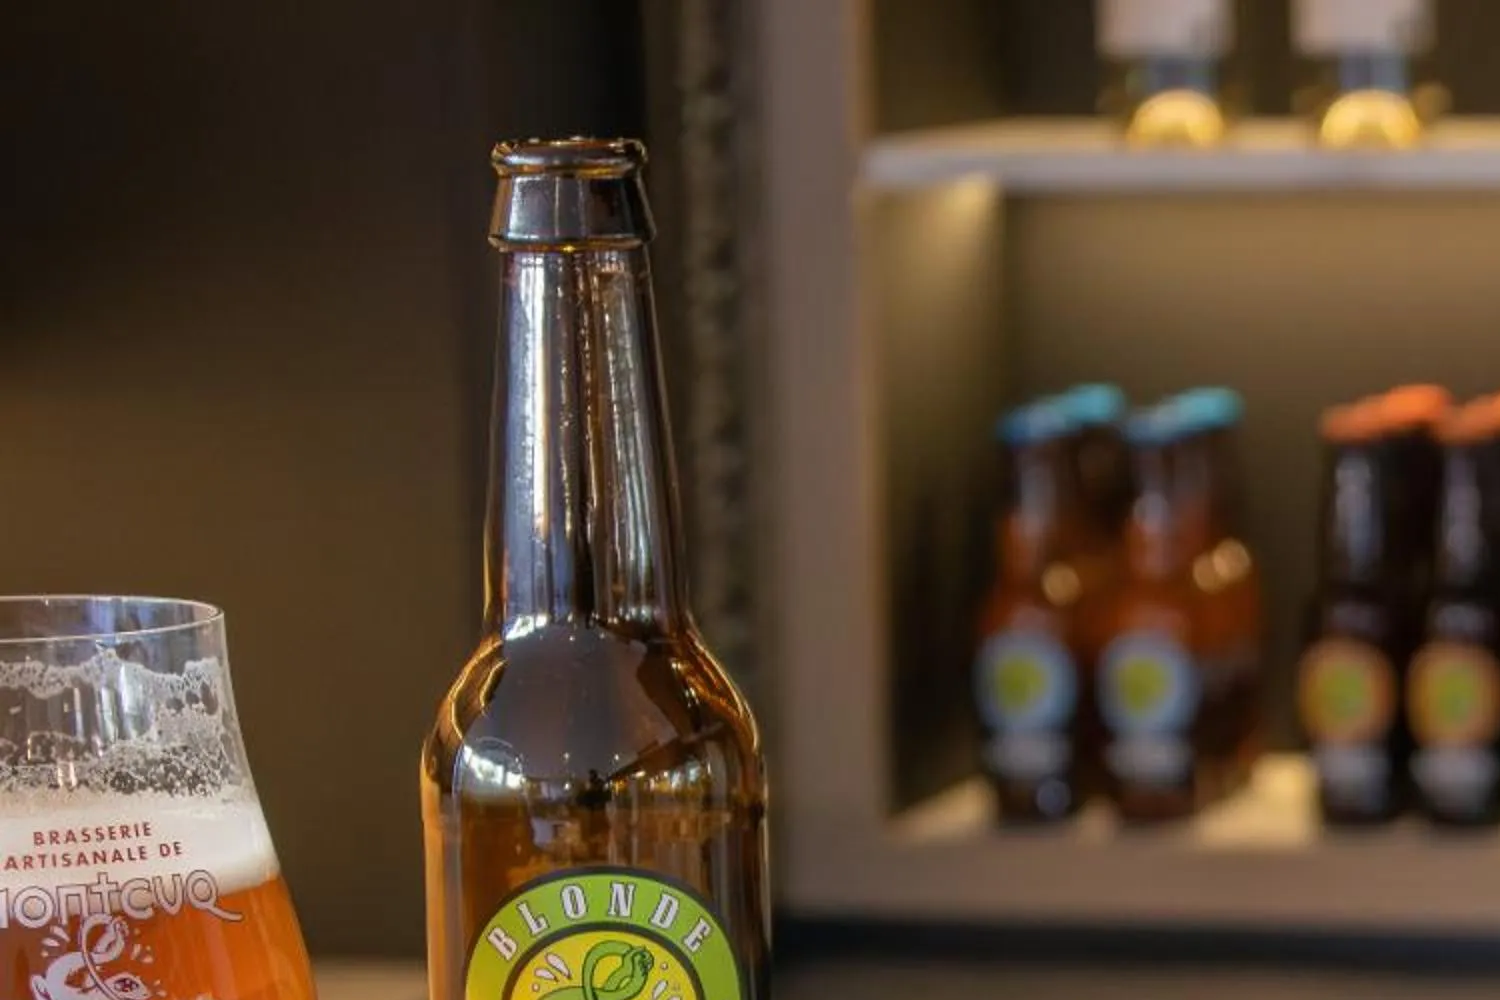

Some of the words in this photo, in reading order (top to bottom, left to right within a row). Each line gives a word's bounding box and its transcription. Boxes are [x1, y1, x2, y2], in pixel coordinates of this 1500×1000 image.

[32, 821, 153, 847] BRASSERIE
[4, 846, 149, 871] ARTISANALE
[159, 841, 184, 857] DE
[487, 881, 712, 961] BLONDE
